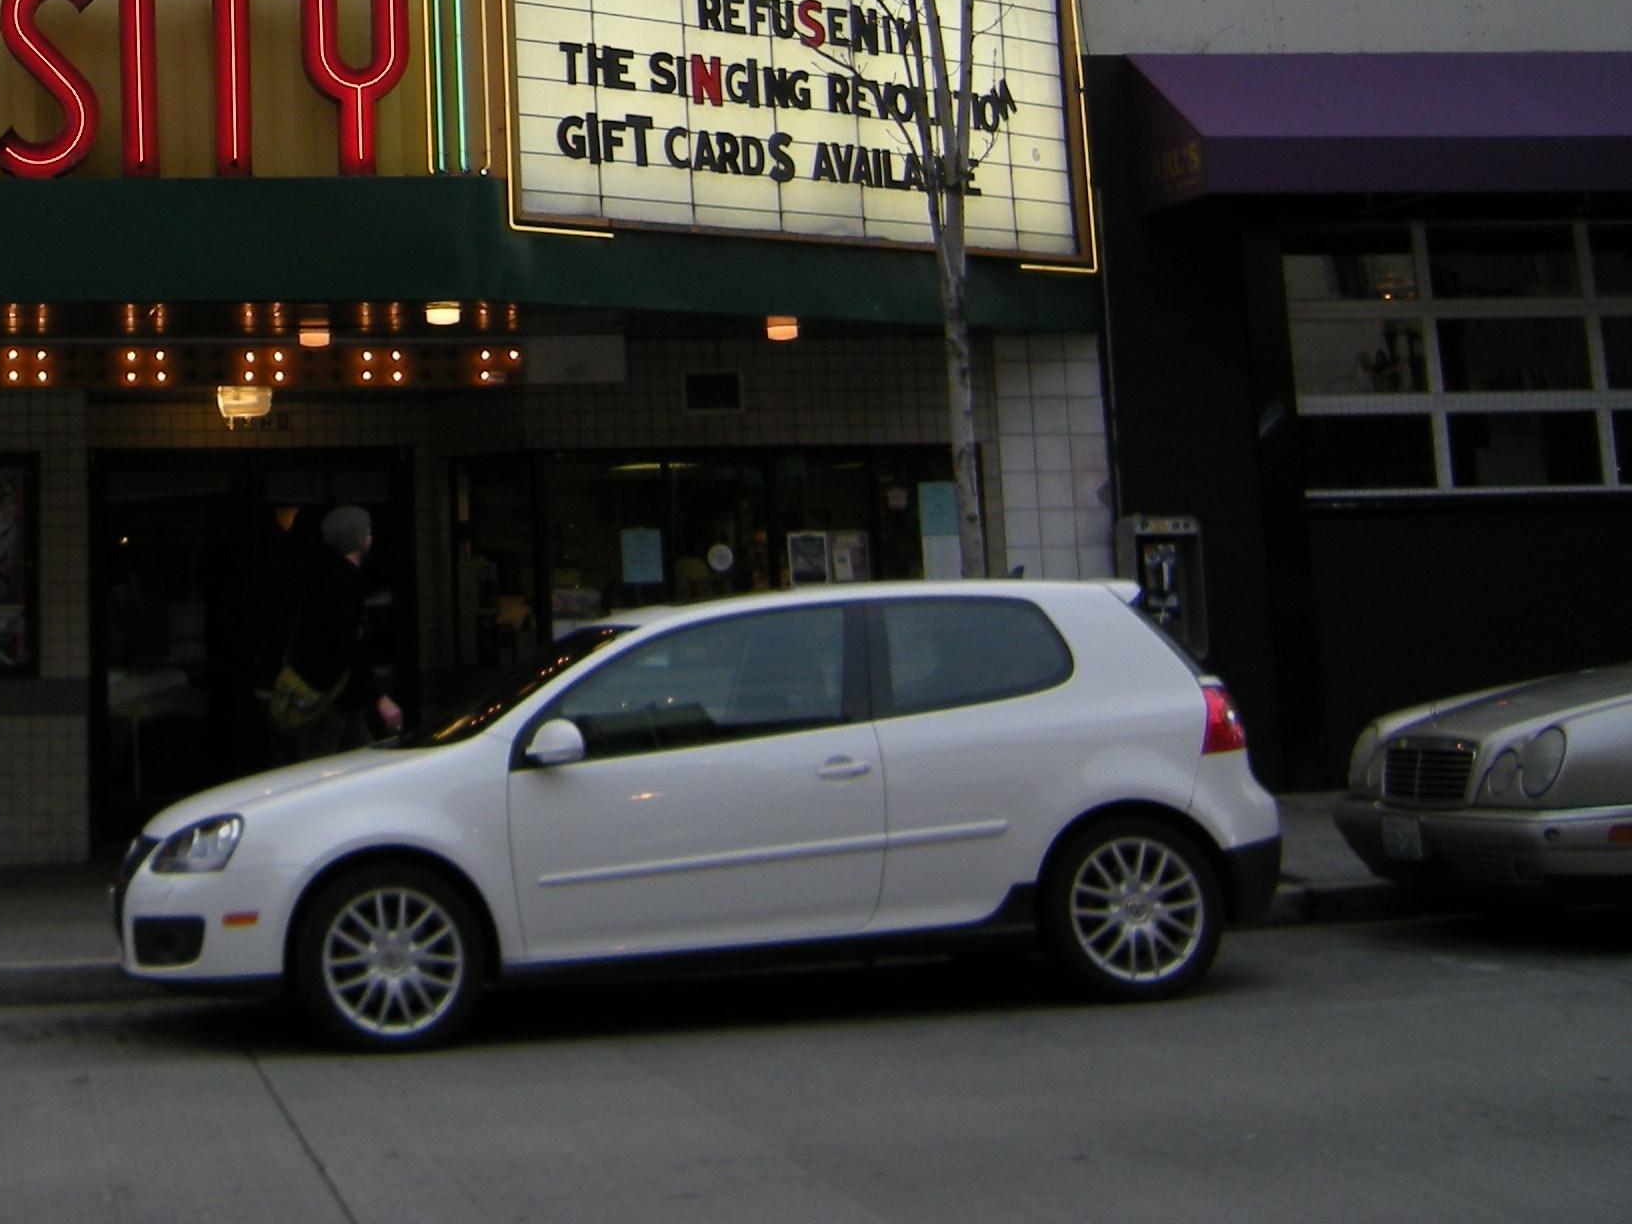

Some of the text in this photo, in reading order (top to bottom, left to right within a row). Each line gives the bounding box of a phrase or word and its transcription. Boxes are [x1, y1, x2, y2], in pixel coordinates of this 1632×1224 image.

[558, 41, 636, 90] THE
[649, 50, 811, 110] SINGING
[556, 112, 654, 167] GIFT
[664, 126, 797, 183] CARDS
